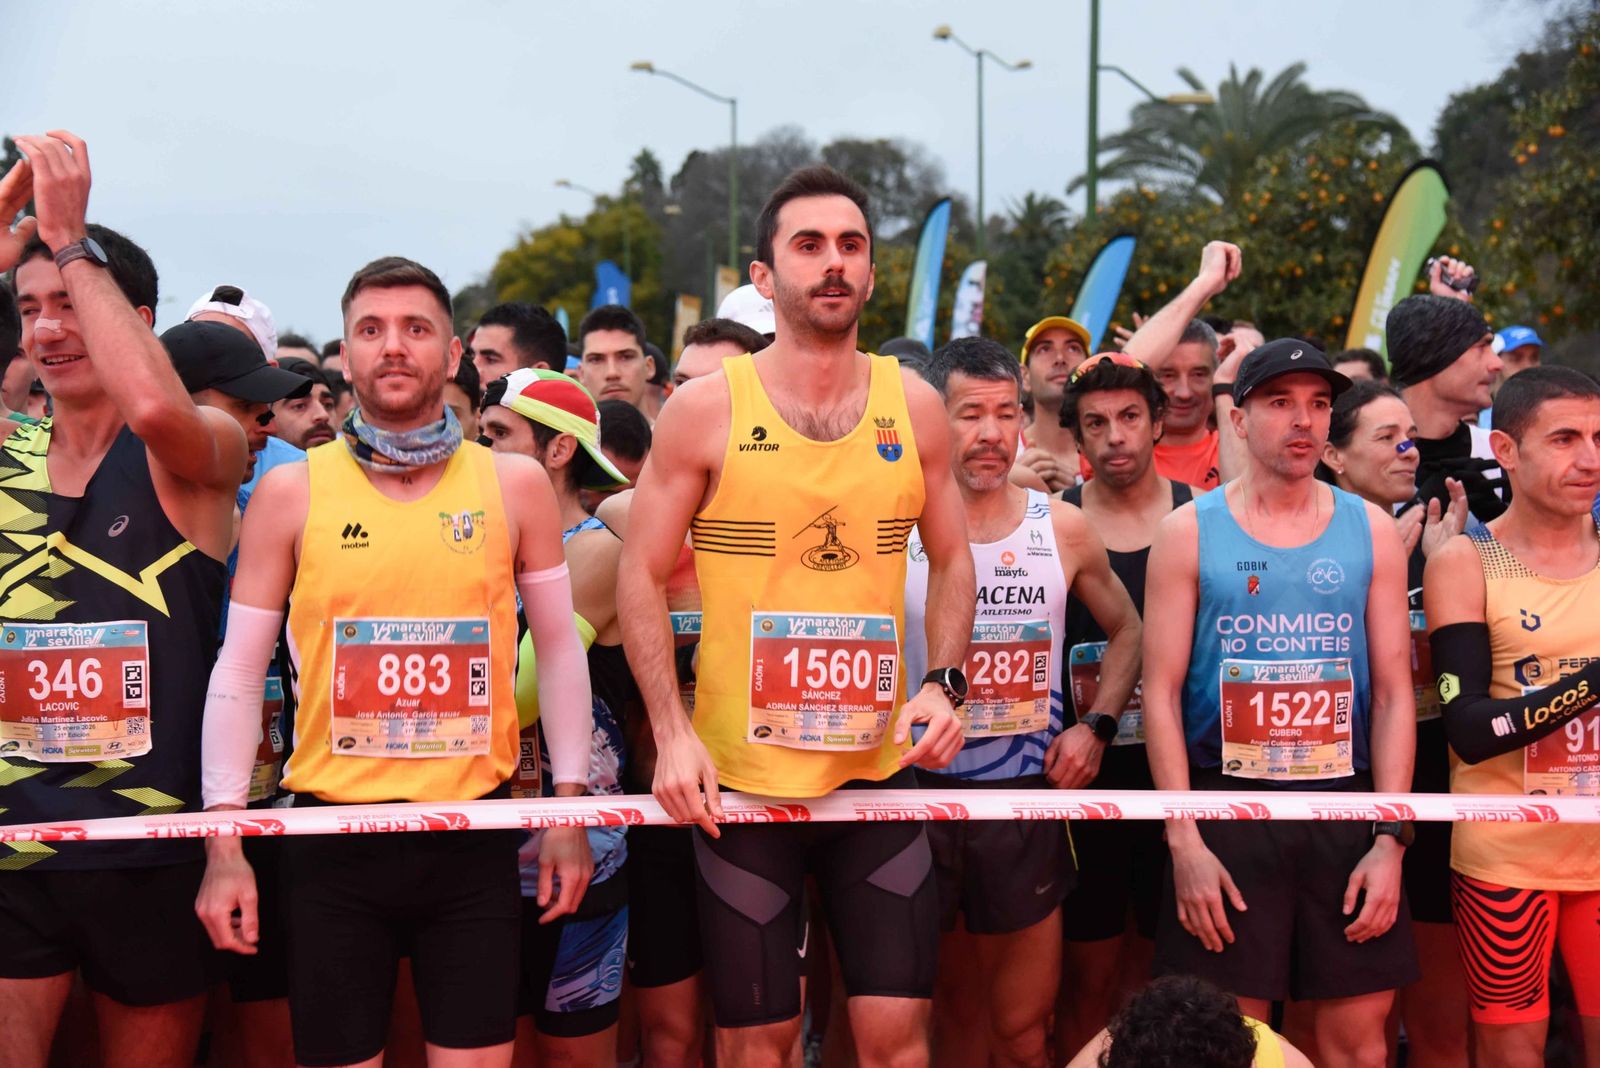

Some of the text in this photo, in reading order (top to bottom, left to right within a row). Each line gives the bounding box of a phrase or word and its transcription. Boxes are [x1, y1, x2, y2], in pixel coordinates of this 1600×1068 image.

[739, 443, 780, 452] VIATOR
[341, 541, 370, 550] mobel
[1237, 561, 1268, 571] GOBIK
[995, 567, 1028, 578] mayfo
[976, 586, 1046, 604] ACENA
[980, 608, 1033, 616] ATLETISMO
[388, 622, 444, 633] maratón
[804, 617, 855, 628] maratón
[1216, 612, 1353, 635] CONMIGO
[33, 627, 92, 638] maratón
[402, 630, 444, 641] sevilla
[817, 626, 855, 637] sevilla
[981, 632, 1015, 641] sevilla
[48, 636, 93, 648] sevilla
[1221, 636, 1350, 653] NO CONTEIS
[783, 647, 873, 689] 1560
[962, 650, 1030, 685] 282
[1268, 663, 1314, 673] maratón
[27, 658, 103, 700] 346
[377, 653, 451, 696] 883
[755, 665, 763, 692] CAJÓN
[1279, 671, 1313, 681] sevilla
[801, 690, 841, 700] SÁNCHEZ
[981, 687, 994, 695] Leo
[40, 702, 80, 712] LACOVIC
[395, 698, 420, 708] Azuar
[766, 702, 797, 711] ADRIÁN
[799, 703, 836, 712] SÁNCHEZ
[1249, 690, 1331, 727] 1522
[1524, 680, 1589, 730] LOCOS
[355, 711, 375, 719] José
[377, 711, 408, 719] Antonio
[1269, 728, 1302, 737] CUBERO
[1271, 739, 1296, 747] Cubero
[1568, 754, 1598, 763] ANTONIO
